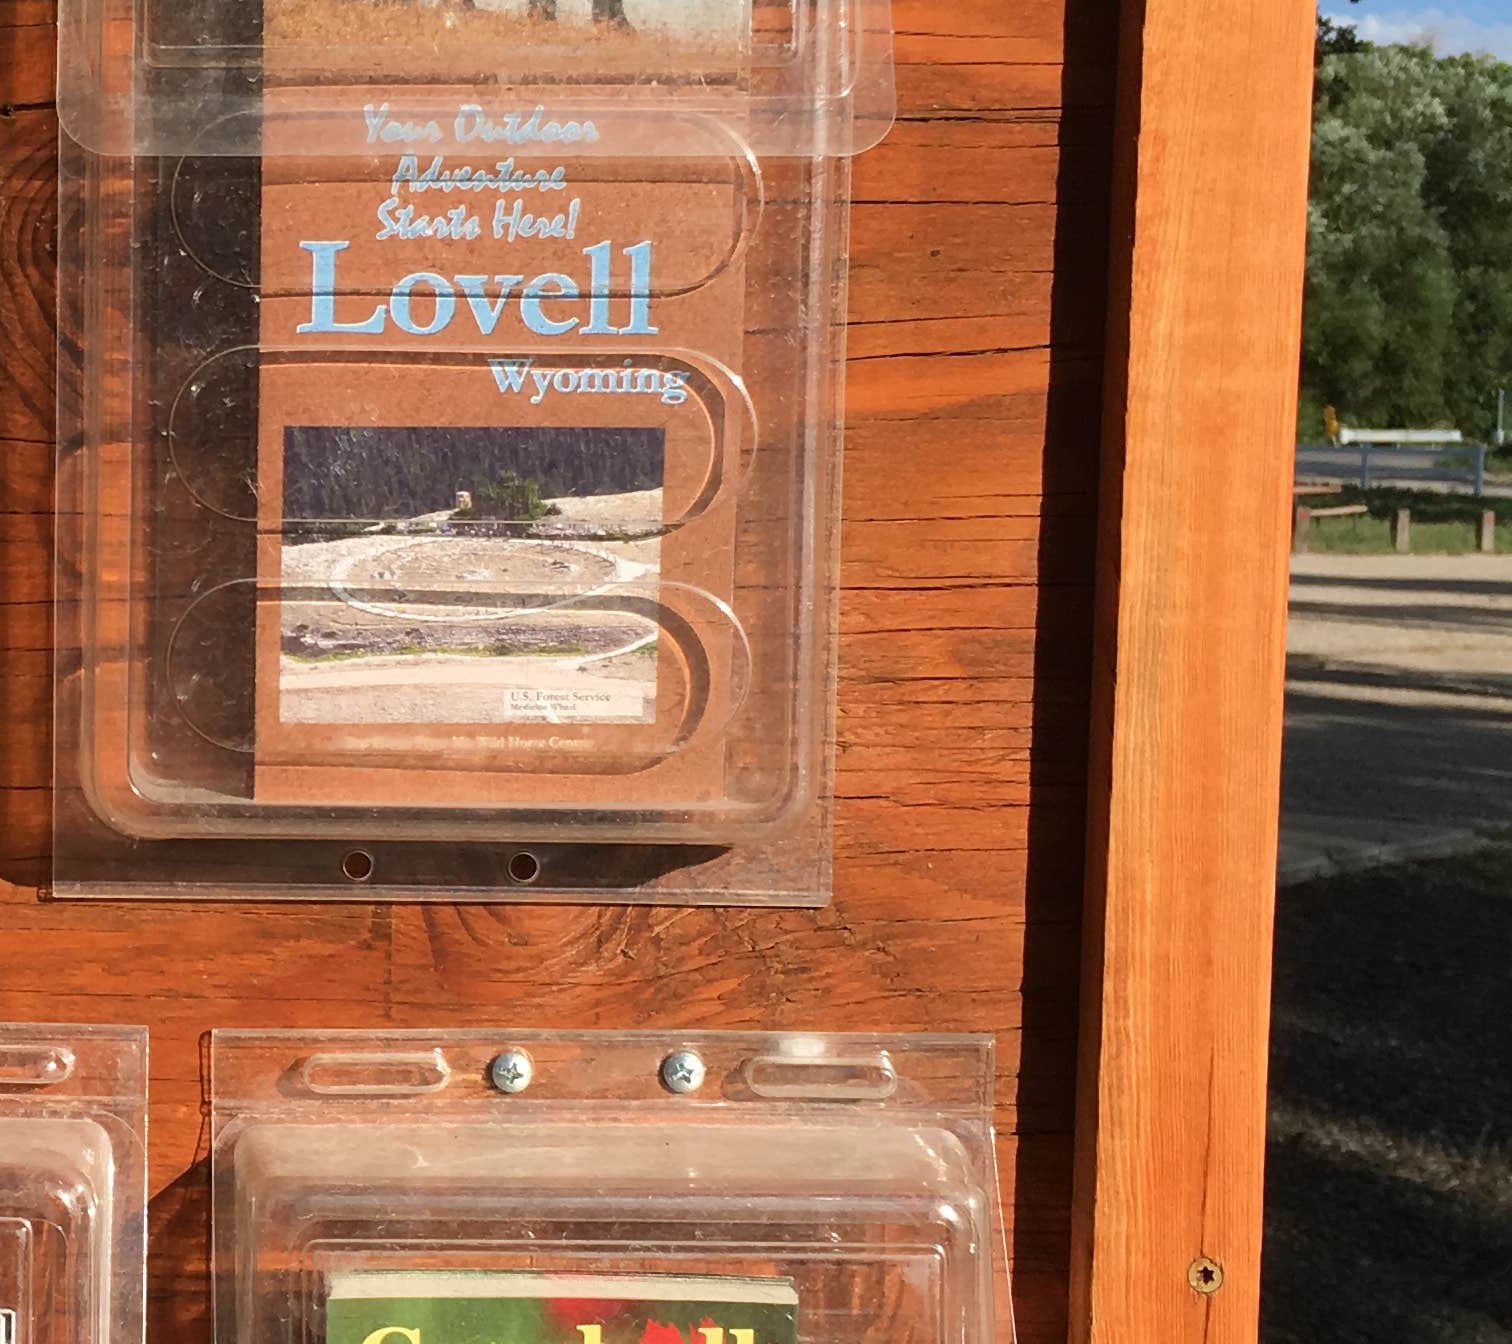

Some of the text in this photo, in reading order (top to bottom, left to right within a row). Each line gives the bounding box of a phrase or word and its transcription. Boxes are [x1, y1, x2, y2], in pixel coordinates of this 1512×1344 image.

[363, 102, 600, 144] Your Outdoor
[390, 151, 568, 195] Adventure
[376, 197, 581, 243] Starts Here!
[296, 240, 659, 336] Lovell
[488, 358, 691, 405] Wyoming
